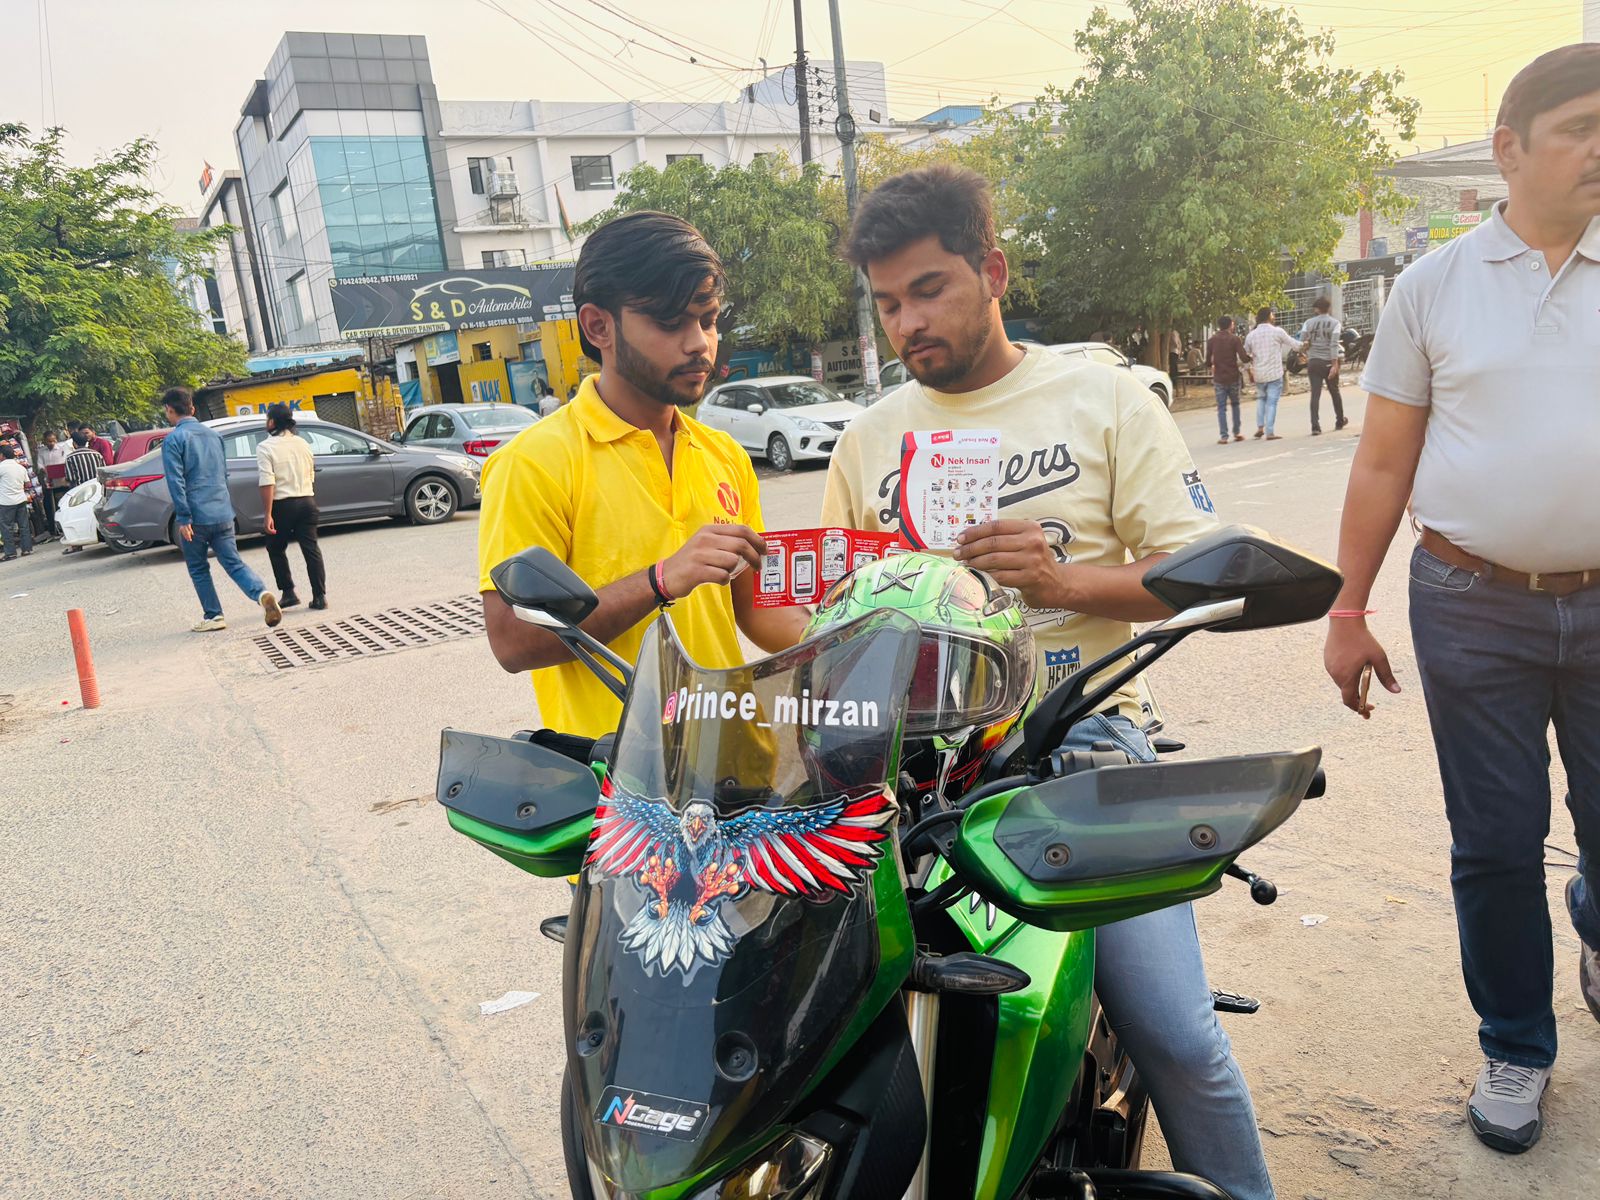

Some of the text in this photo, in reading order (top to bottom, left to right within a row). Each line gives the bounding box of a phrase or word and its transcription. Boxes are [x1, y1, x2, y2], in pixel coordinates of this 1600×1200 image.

[1460, 214, 1480, 223] Castrol
[1430, 227, 1450, 239] NOIDA
[410, 302, 423, 321] S
[430, 301, 445, 319] &
[450, 299, 466, 318] D
[468, 296, 532, 315] Automobiles
[345, 331, 358, 340] CAR
[359, 329, 383, 339] SERVICE
[392, 326, 417, 336] DENTING
[419, 323, 446, 333] PAINTING
[841, 345, 859, 356] S &
[480, 378, 502, 402] MAK
[677, 684, 879, 727] Prince_mirzan
